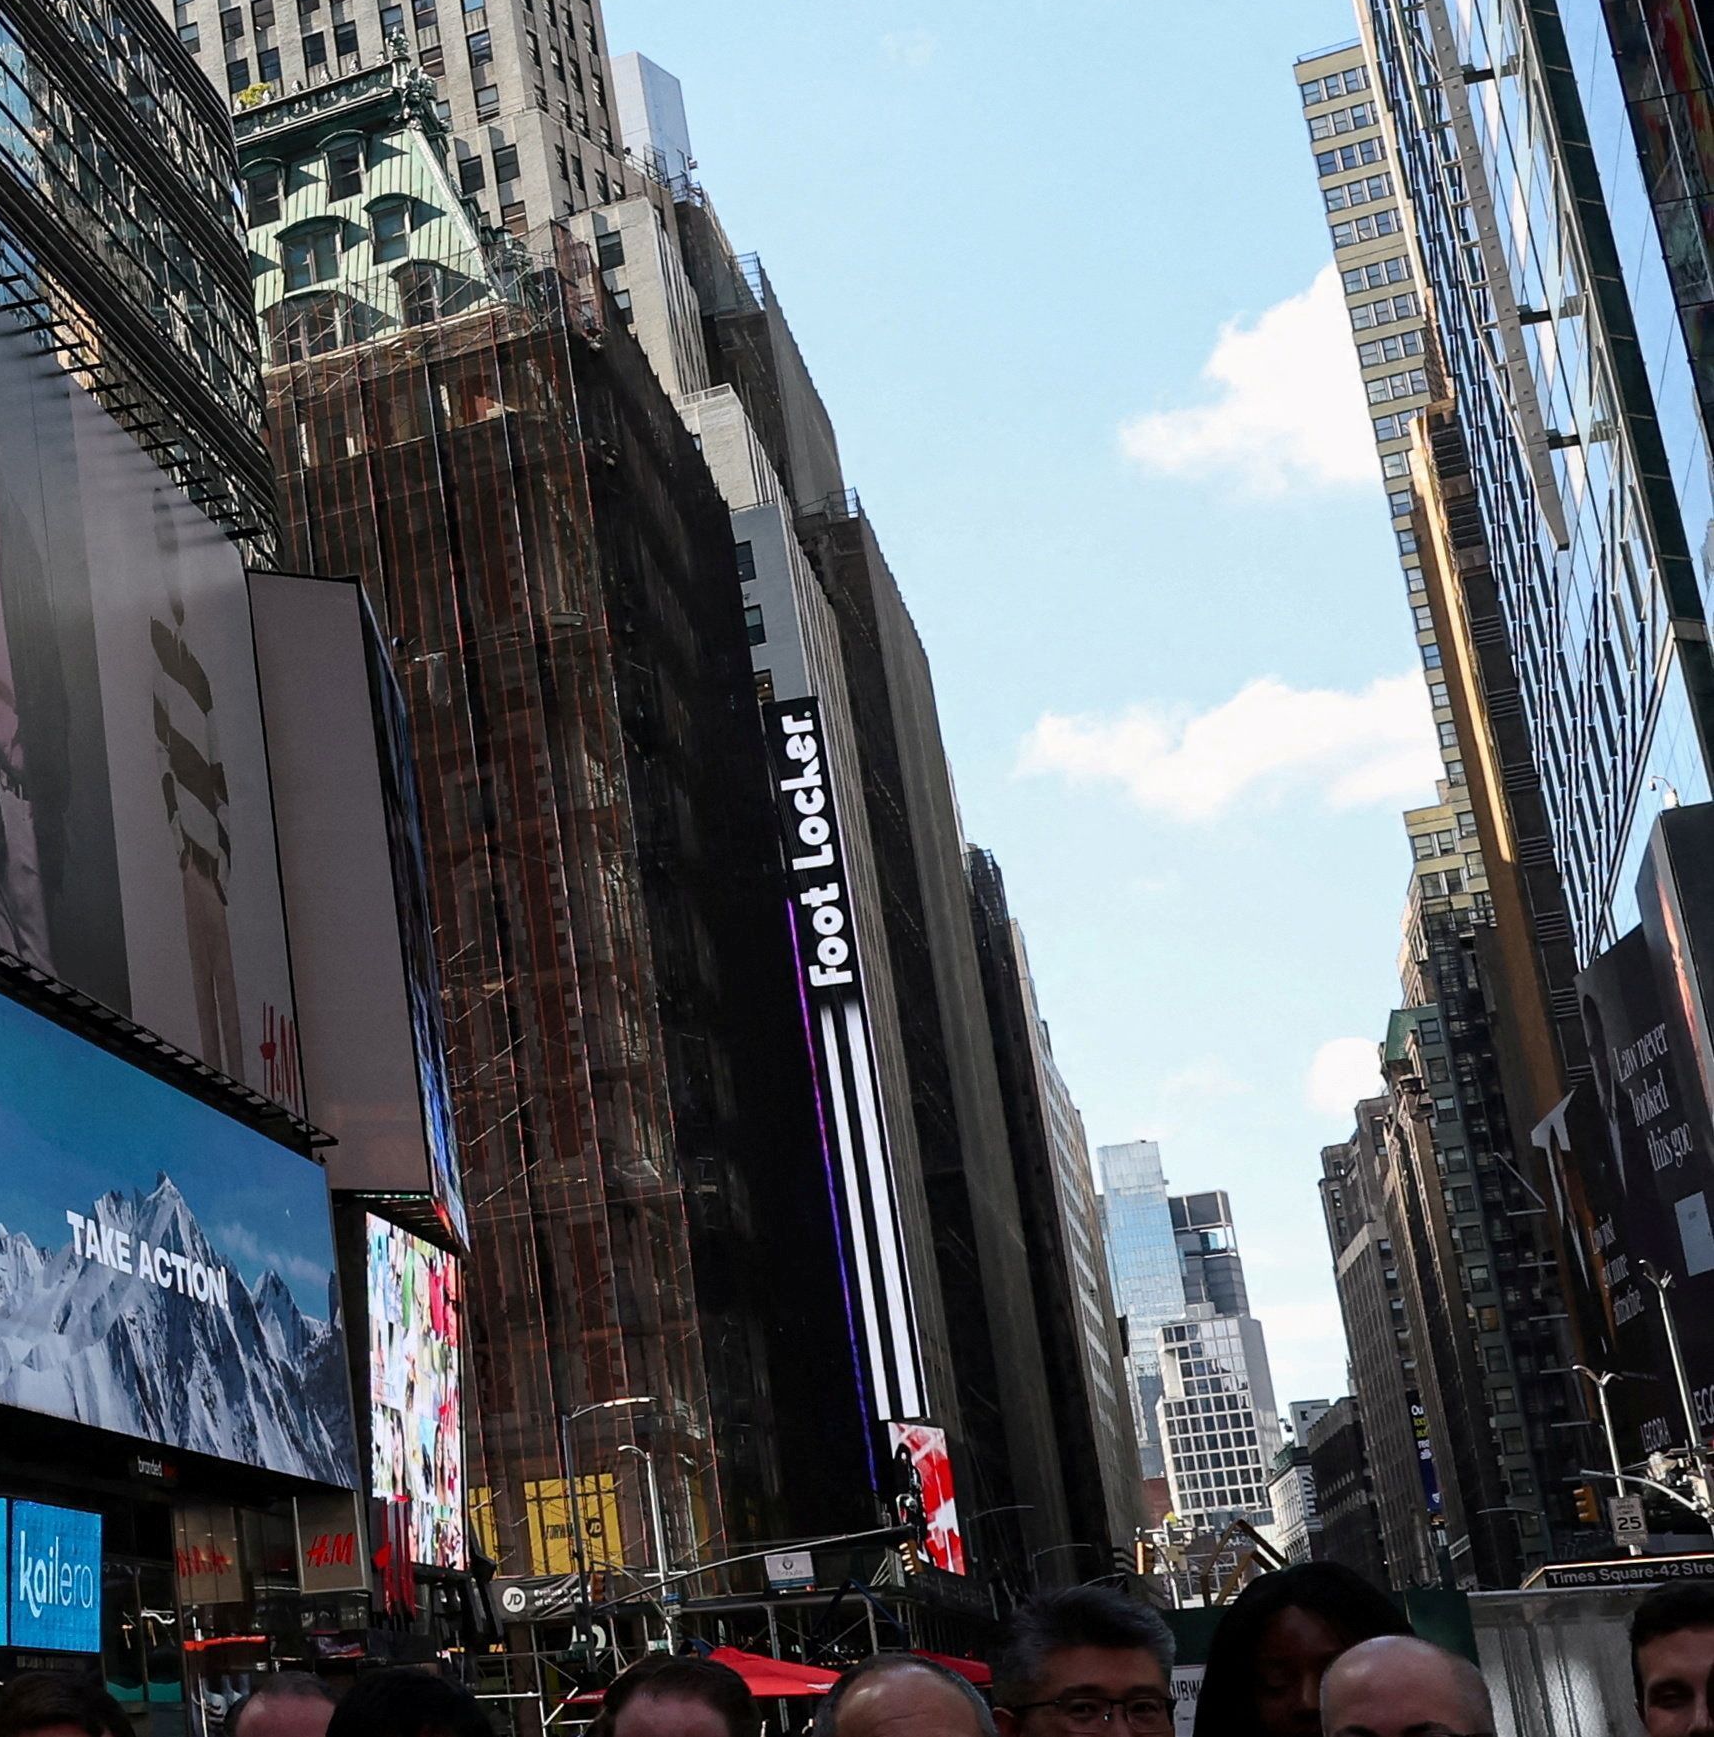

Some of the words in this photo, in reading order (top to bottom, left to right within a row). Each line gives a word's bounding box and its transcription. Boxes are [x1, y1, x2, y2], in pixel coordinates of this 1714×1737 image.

[780, 714, 835, 871] Locker
[800, 882, 853, 987] Foot
[1613, 1047, 1639, 1082] Law
[1637, 1023, 1668, 1067] never
[1629, 1069, 1670, 1127] looked
[1647, 1127, 1673, 1171] this
[66, 1210, 133, 1275] TAKE
[139, 1240, 229, 1311] ACTION!
[306, 1532, 354, 1568] H&M
[1617, 1516, 1642, 1531] 25
[20, 1530, 95, 1618] kailera
[1550, 1571, 1596, 1585] Times
